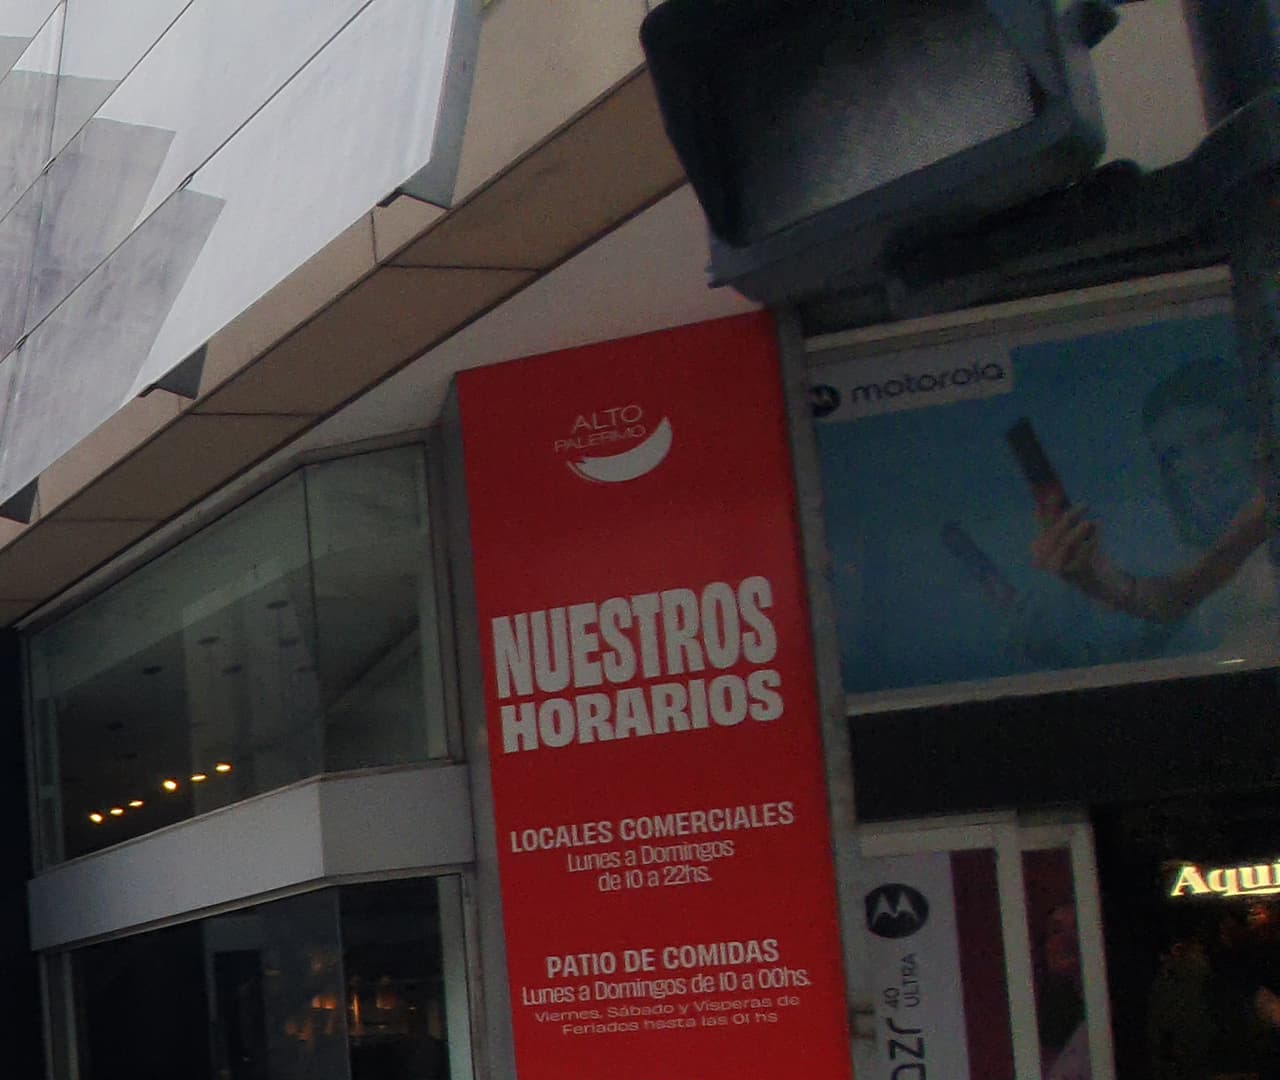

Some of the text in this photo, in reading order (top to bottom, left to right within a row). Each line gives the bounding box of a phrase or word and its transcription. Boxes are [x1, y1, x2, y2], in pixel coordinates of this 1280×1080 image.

[851, 361, 1006, 402] motorola
[571, 404, 643, 434] ALTO
[553, 424, 646, 453] PALERMO
[492, 576, 777, 698] NUESTROS
[501, 669, 784, 753] HORARIOS
[510, 801, 795, 853] LOCALES COMERCIALES
[567, 840, 735, 873] Lunes a Domingos
[598, 871, 622, 892] de
[648, 870, 660, 888] a
[663, 864, 713, 886] 22hs.
[546, 938, 780, 978] PATIO DE COMIDAS
[522, 985, 575, 1006] Lunes
[579, 984, 591, 1002] a
[594, 977, 687, 1001] Domingos
[691, 971, 715, 994] de
[741, 971, 754, 990] a
[901, 952, 921, 1008] ULTRA
[607, 1001, 675, 1019] Sábado
[679, 1004, 689, 1016] y
[777, 993, 801, 1007] de
[883, 987, 900, 1009] 40
[562, 1020, 640, 1036] Feriados
[644, 1016, 697, 1031] hasta
[701, 1013, 729, 1027] las
[755, 1011, 778, 1025] hs
